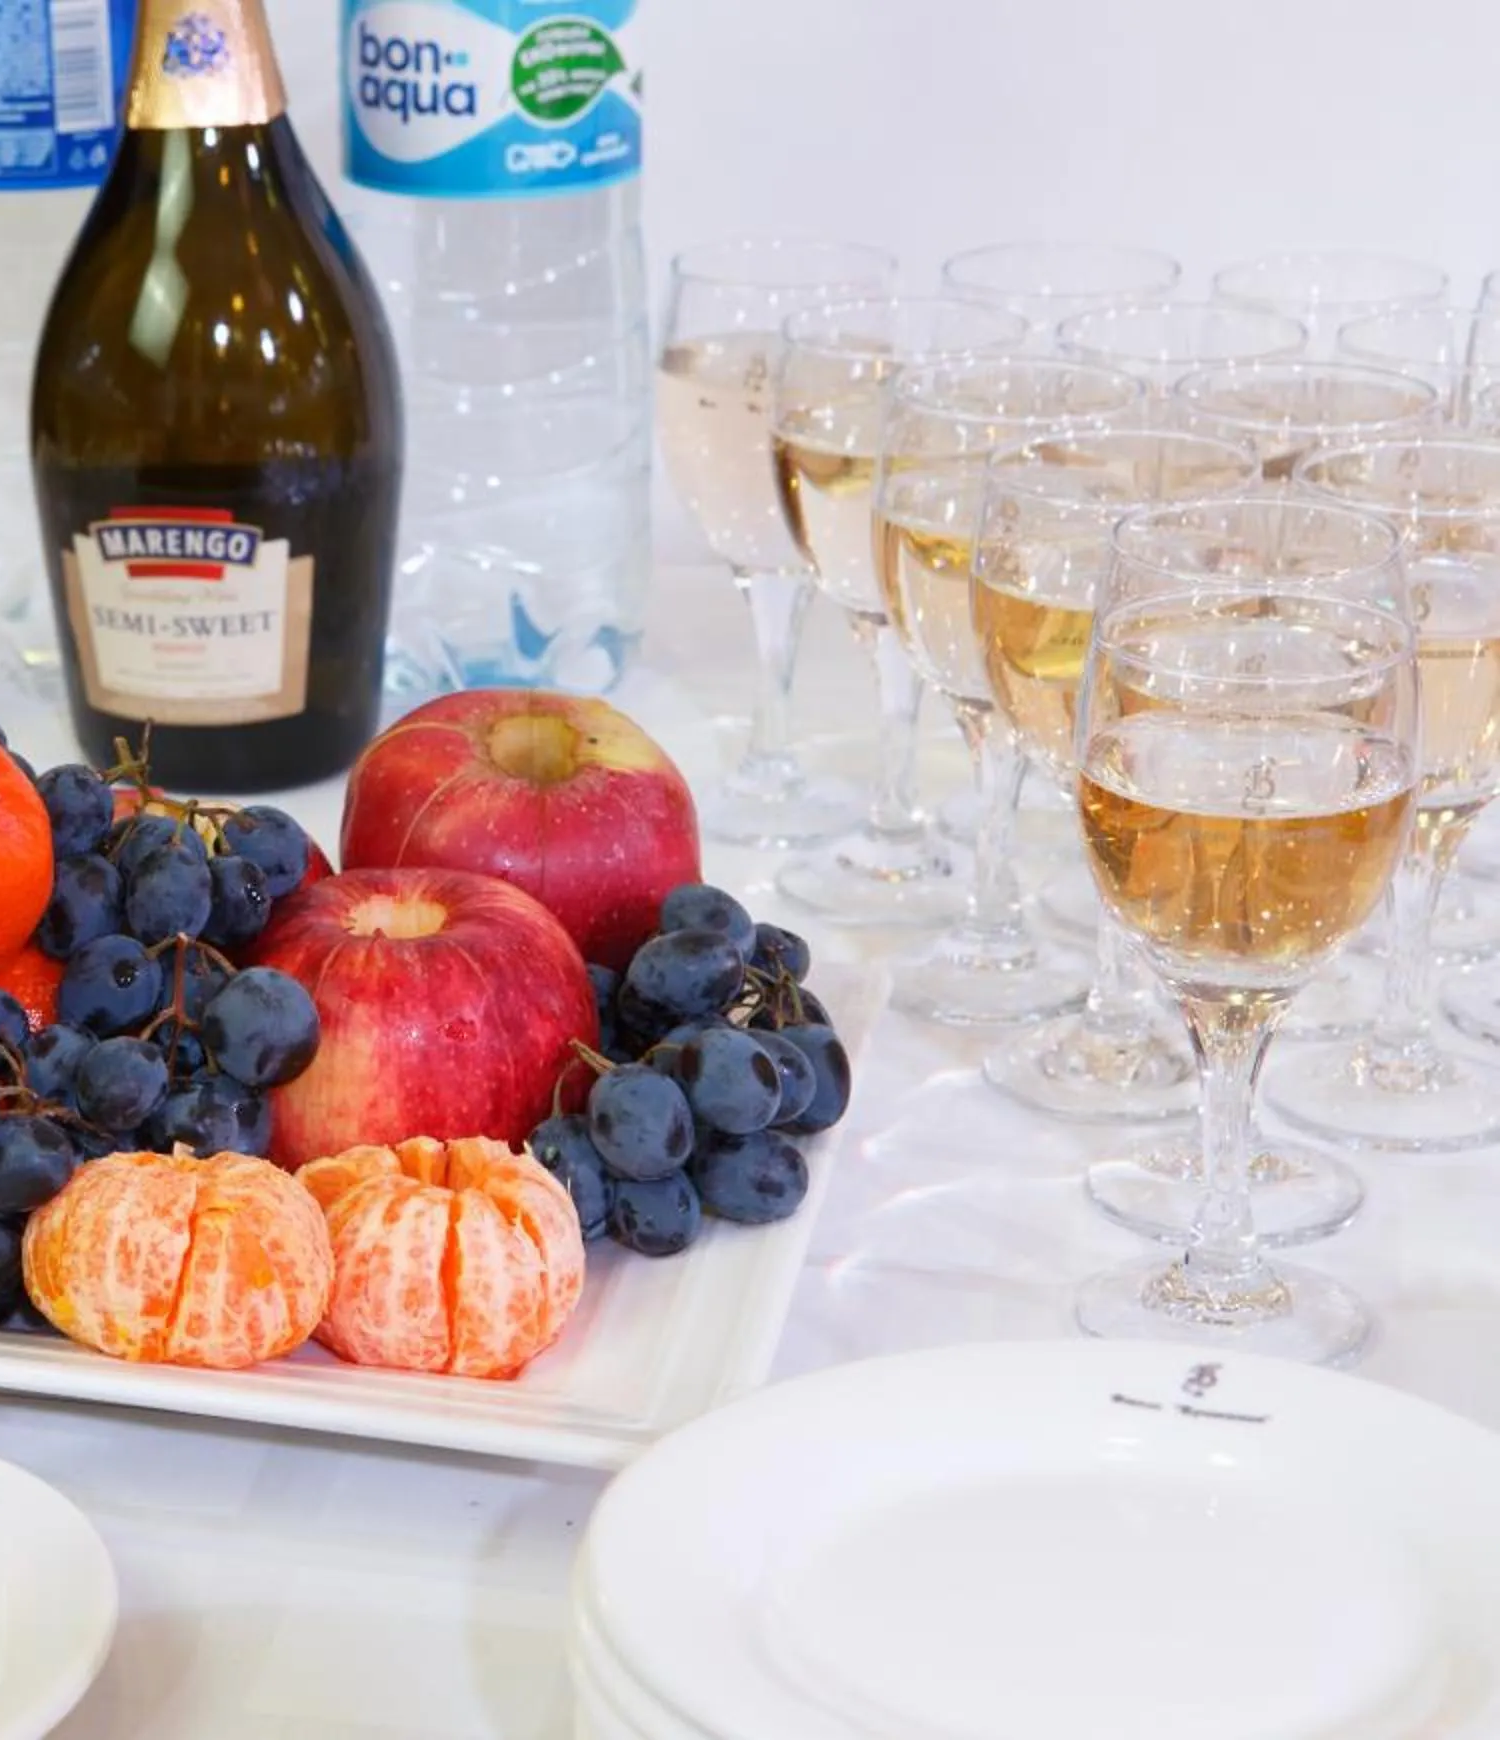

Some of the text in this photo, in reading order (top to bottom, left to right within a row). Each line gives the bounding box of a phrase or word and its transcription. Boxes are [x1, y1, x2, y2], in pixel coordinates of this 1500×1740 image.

[359, 22, 440, 73] bon
[359, 75, 476, 124] aqua
[101, 528, 250, 560] MARENGO
